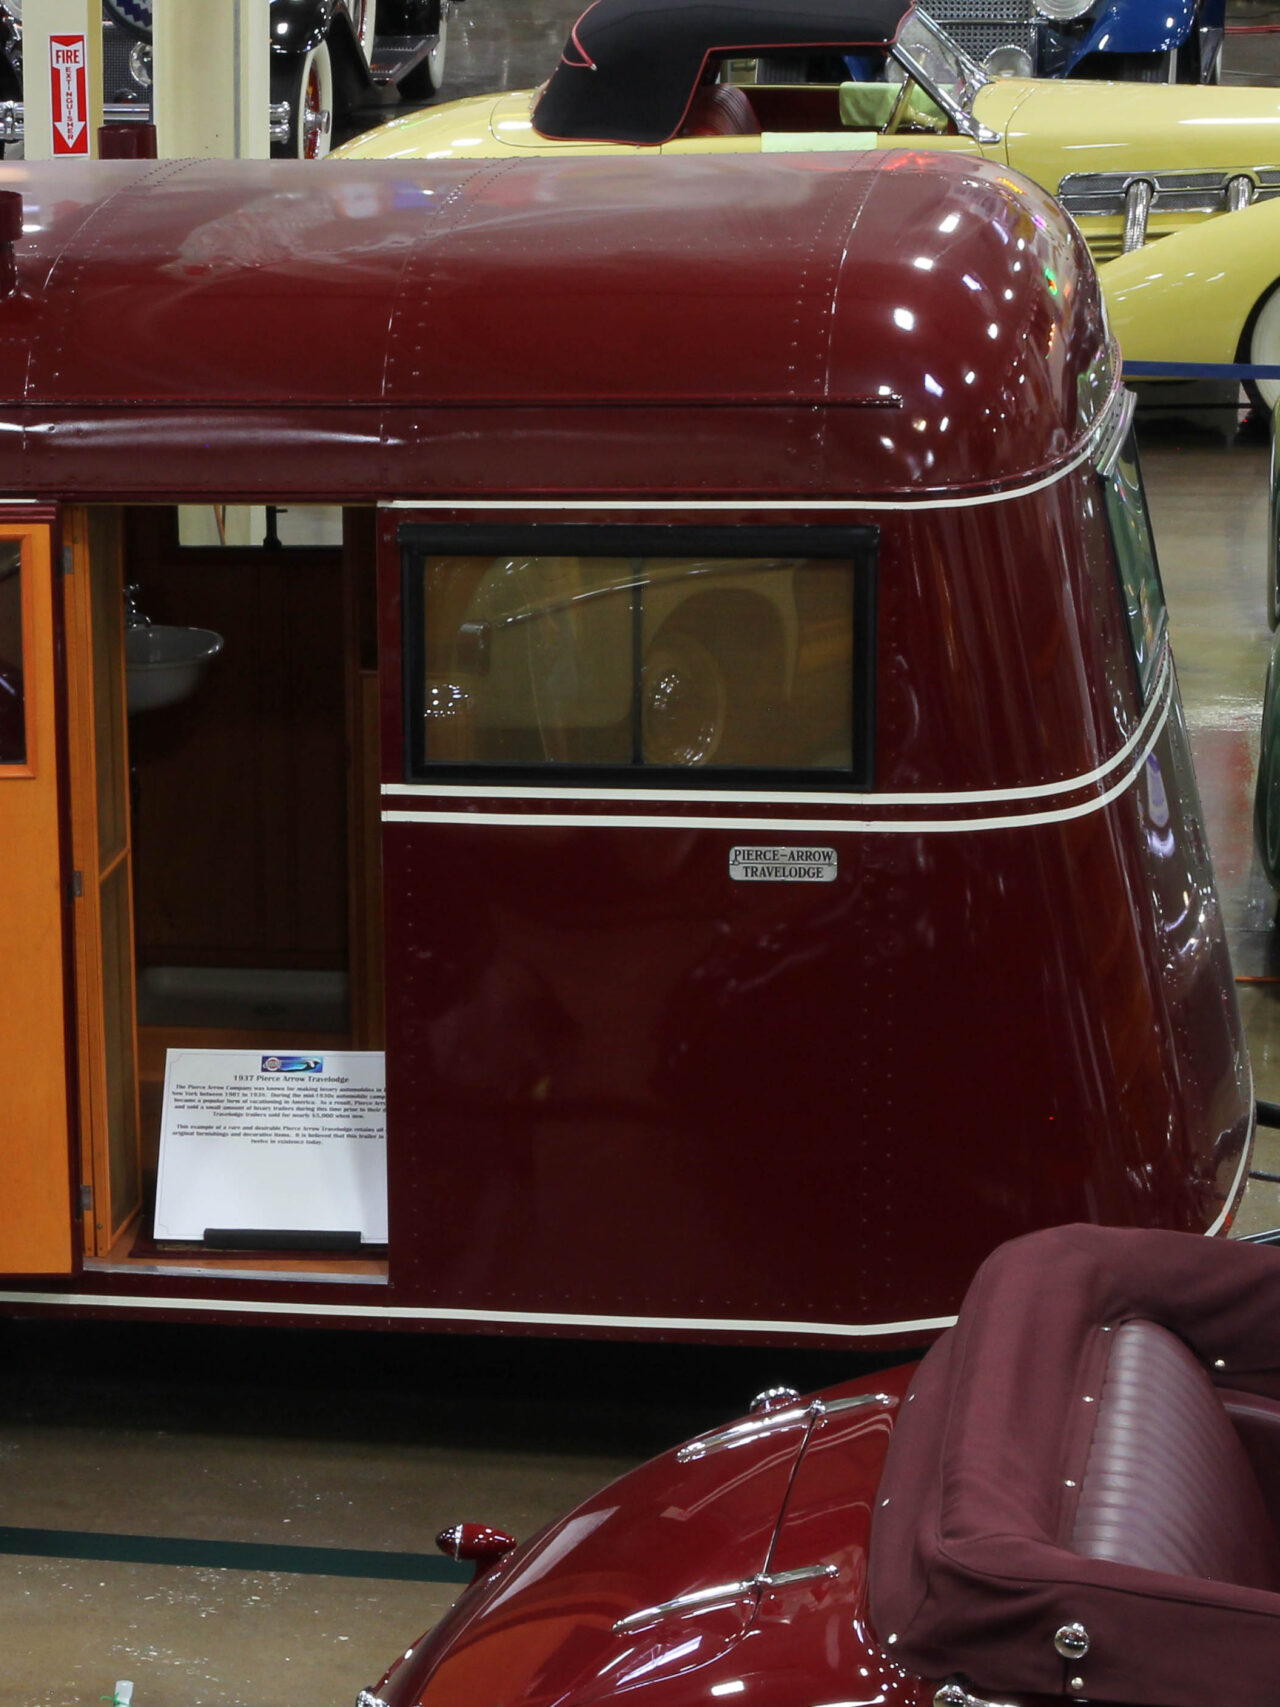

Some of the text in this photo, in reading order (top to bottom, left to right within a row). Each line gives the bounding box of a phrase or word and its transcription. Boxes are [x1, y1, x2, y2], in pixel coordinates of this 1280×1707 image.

[56, 50, 80, 64] FIRE
[65, 67, 74, 140] EXTINGUISHER
[733, 849, 834, 862] PIERCE-ARROW
[742, 866, 824, 879] TRAVELODGE
